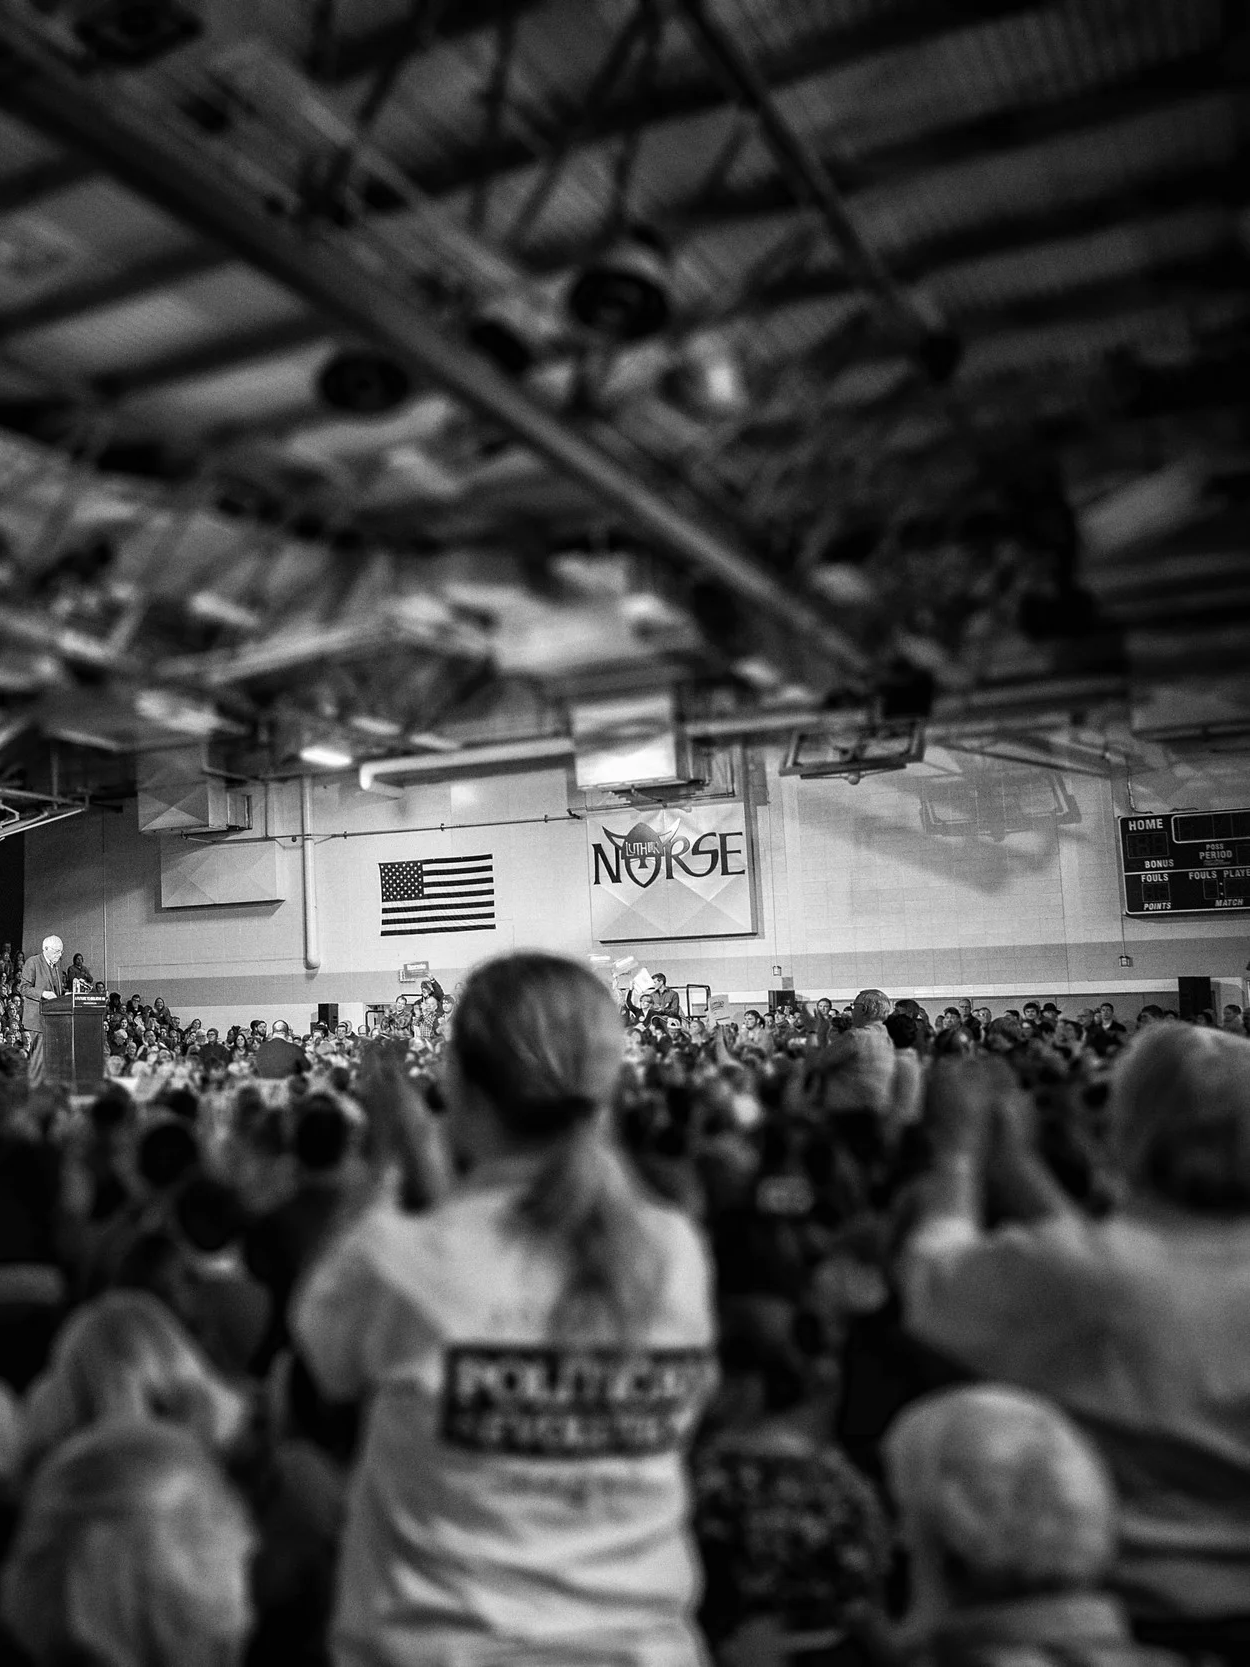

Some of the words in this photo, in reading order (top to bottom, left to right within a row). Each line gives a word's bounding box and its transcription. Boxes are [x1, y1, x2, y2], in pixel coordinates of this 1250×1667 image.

[1128, 819, 1163, 831] HOME
[1199, 850, 1232, 860] PERIOD
[1144, 859, 1174, 868] BONUS
[1141, 873, 1169, 882] FOULS
[1189, 871, 1217, 880] FOULS
[1143, 902, 1172, 911] POINTS
[1215, 899, 1244, 907] MATCH
